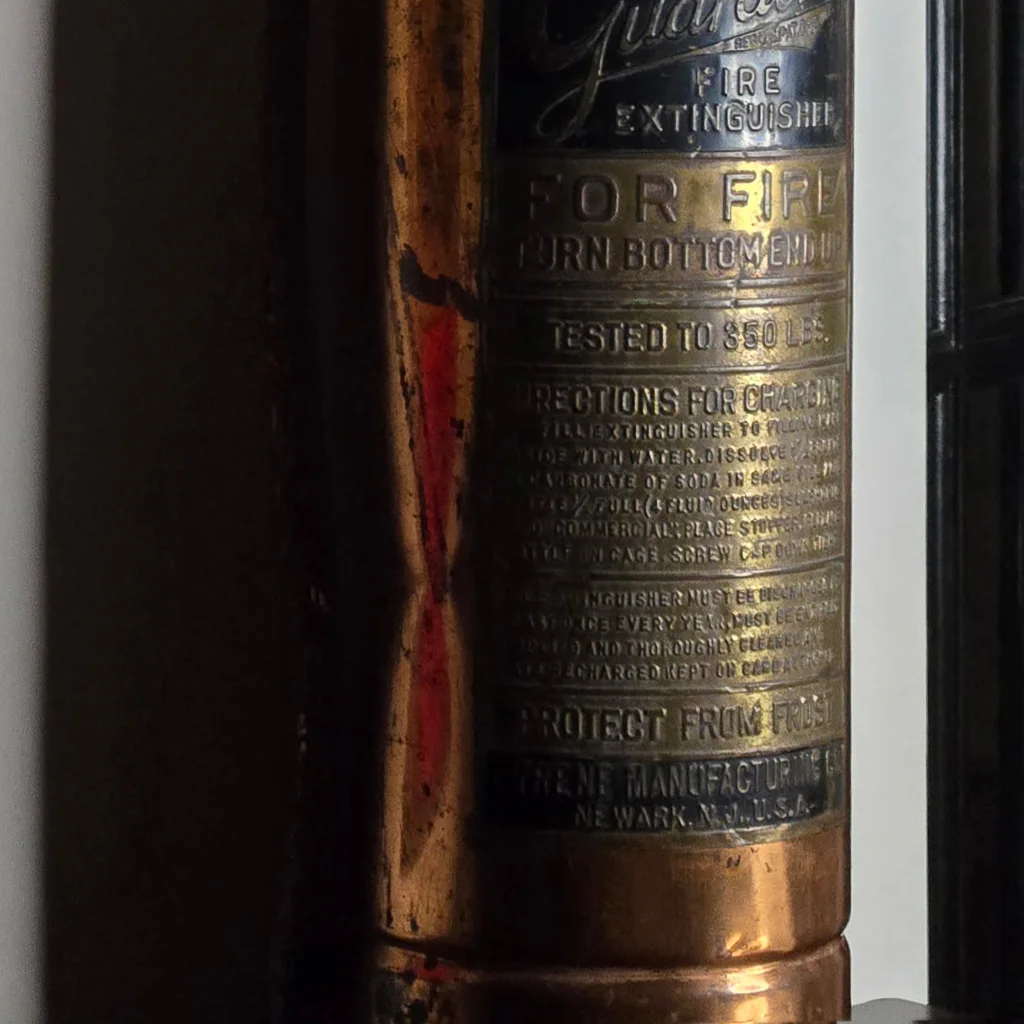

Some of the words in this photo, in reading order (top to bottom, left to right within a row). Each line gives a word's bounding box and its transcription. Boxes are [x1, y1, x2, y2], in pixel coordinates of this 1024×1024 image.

[695, 65, 782, 97] FIRE
[528, 172, 678, 224] FOR
[722, 168, 838, 224] FIRE
[623, 235, 761, 271] BOTTOM
[770, 229, 816, 267] END
[548, 320, 669, 353] TESTED
[677, 320, 713, 352] TO
[723, 318, 777, 351] 350
[687, 386, 736, 416] FOR
[592, 420, 733, 440] EXTINGUISHER
[643, 472, 668, 490] OF
[674, 472, 720, 490] SODA
[615, 613, 676, 633] EVERY
[681, 702, 762, 741] FROM
